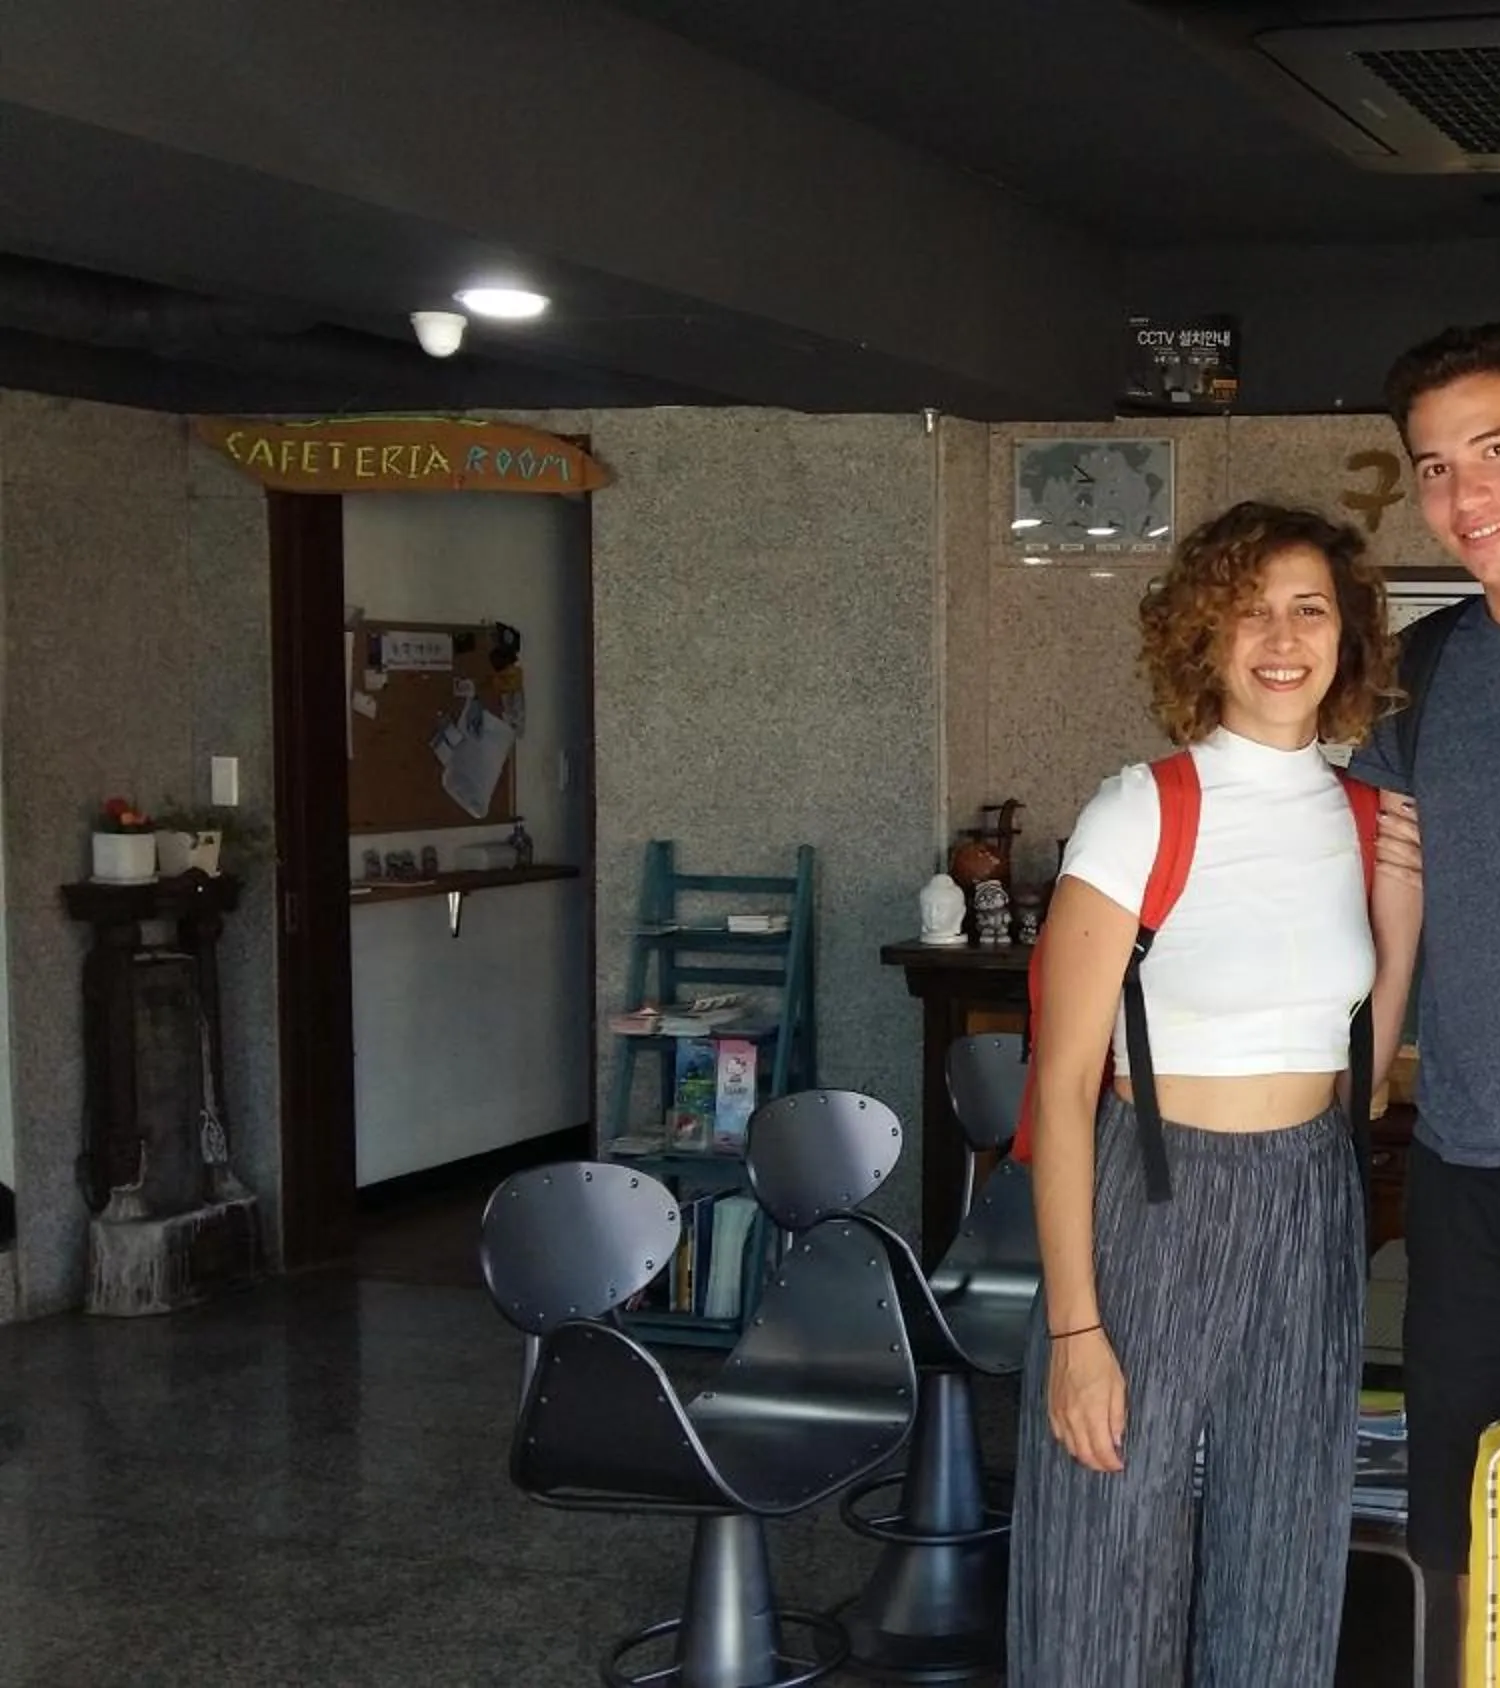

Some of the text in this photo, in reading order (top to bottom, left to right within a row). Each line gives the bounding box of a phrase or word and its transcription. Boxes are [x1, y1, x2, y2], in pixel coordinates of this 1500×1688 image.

[1137, 330, 1231, 347] CCTV 설치안내
[226, 431, 568, 482] CAFETERIA ROOM
